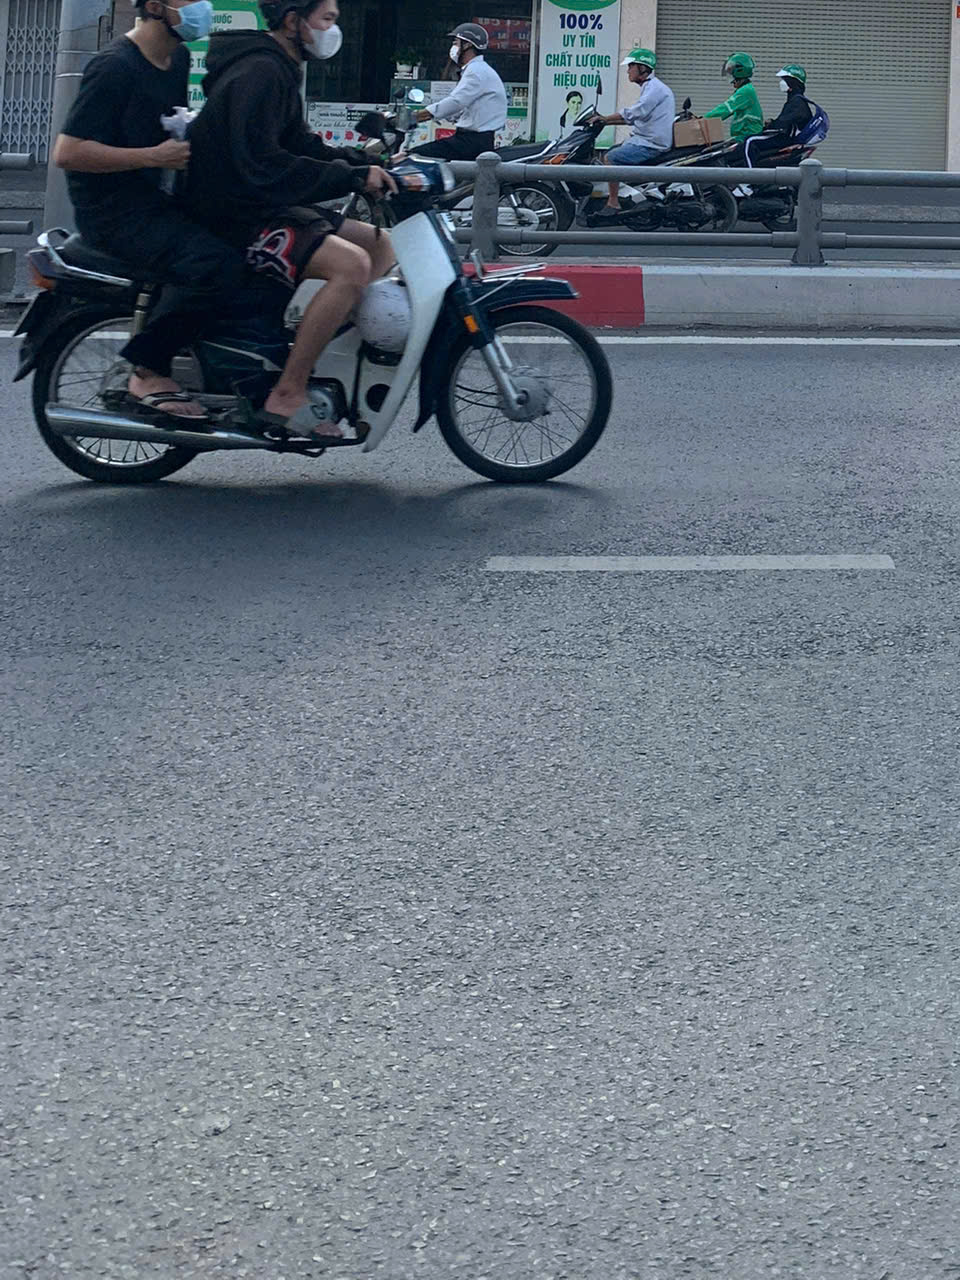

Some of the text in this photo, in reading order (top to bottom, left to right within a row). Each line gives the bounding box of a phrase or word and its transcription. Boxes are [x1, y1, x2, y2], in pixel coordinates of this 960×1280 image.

[559, 13, 603, 30] 100%
[562, 32, 595, 48] UY TÍN
[545, 51, 611, 70] CHẤT LƯỢNG
[553, 71, 577, 90] HIỆU
